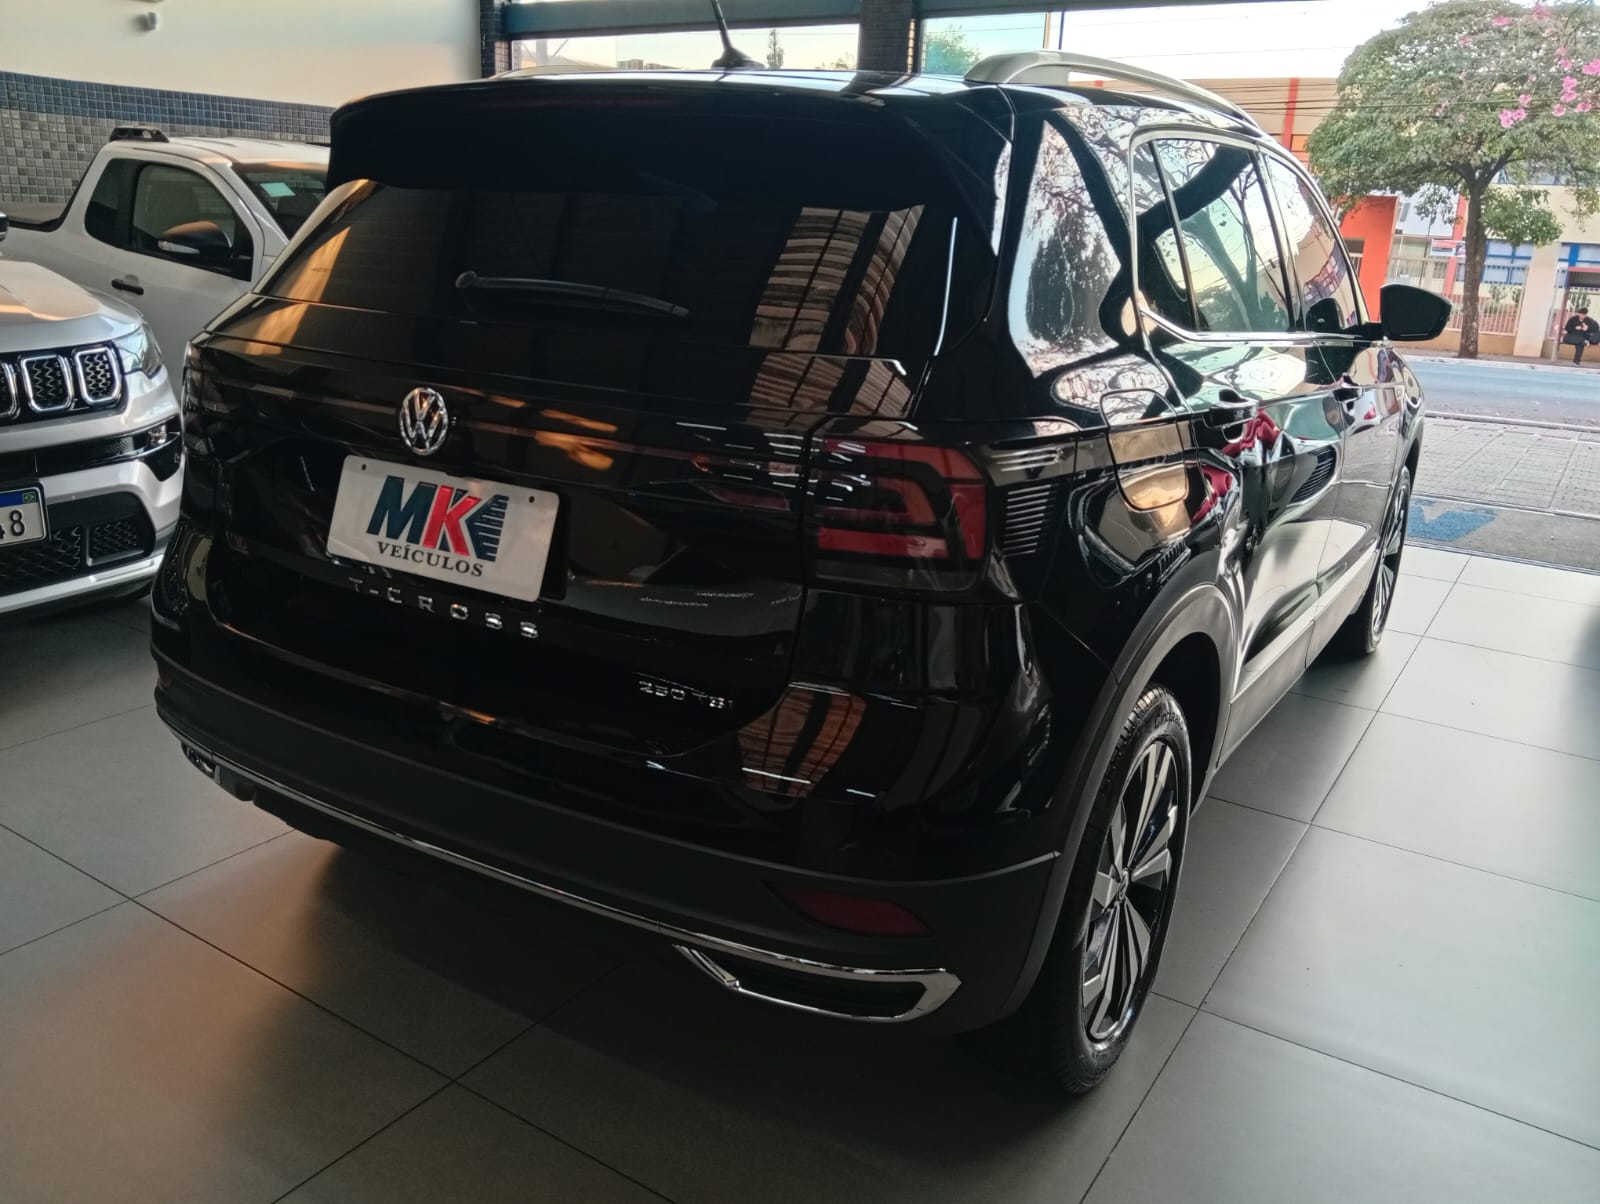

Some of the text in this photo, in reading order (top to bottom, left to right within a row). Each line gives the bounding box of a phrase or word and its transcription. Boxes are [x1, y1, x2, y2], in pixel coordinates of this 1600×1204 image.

[366, 475, 482, 557] MK
[377, 541, 484, 577] VEÍCULOS
[349, 576, 538, 638] T-CROSS
